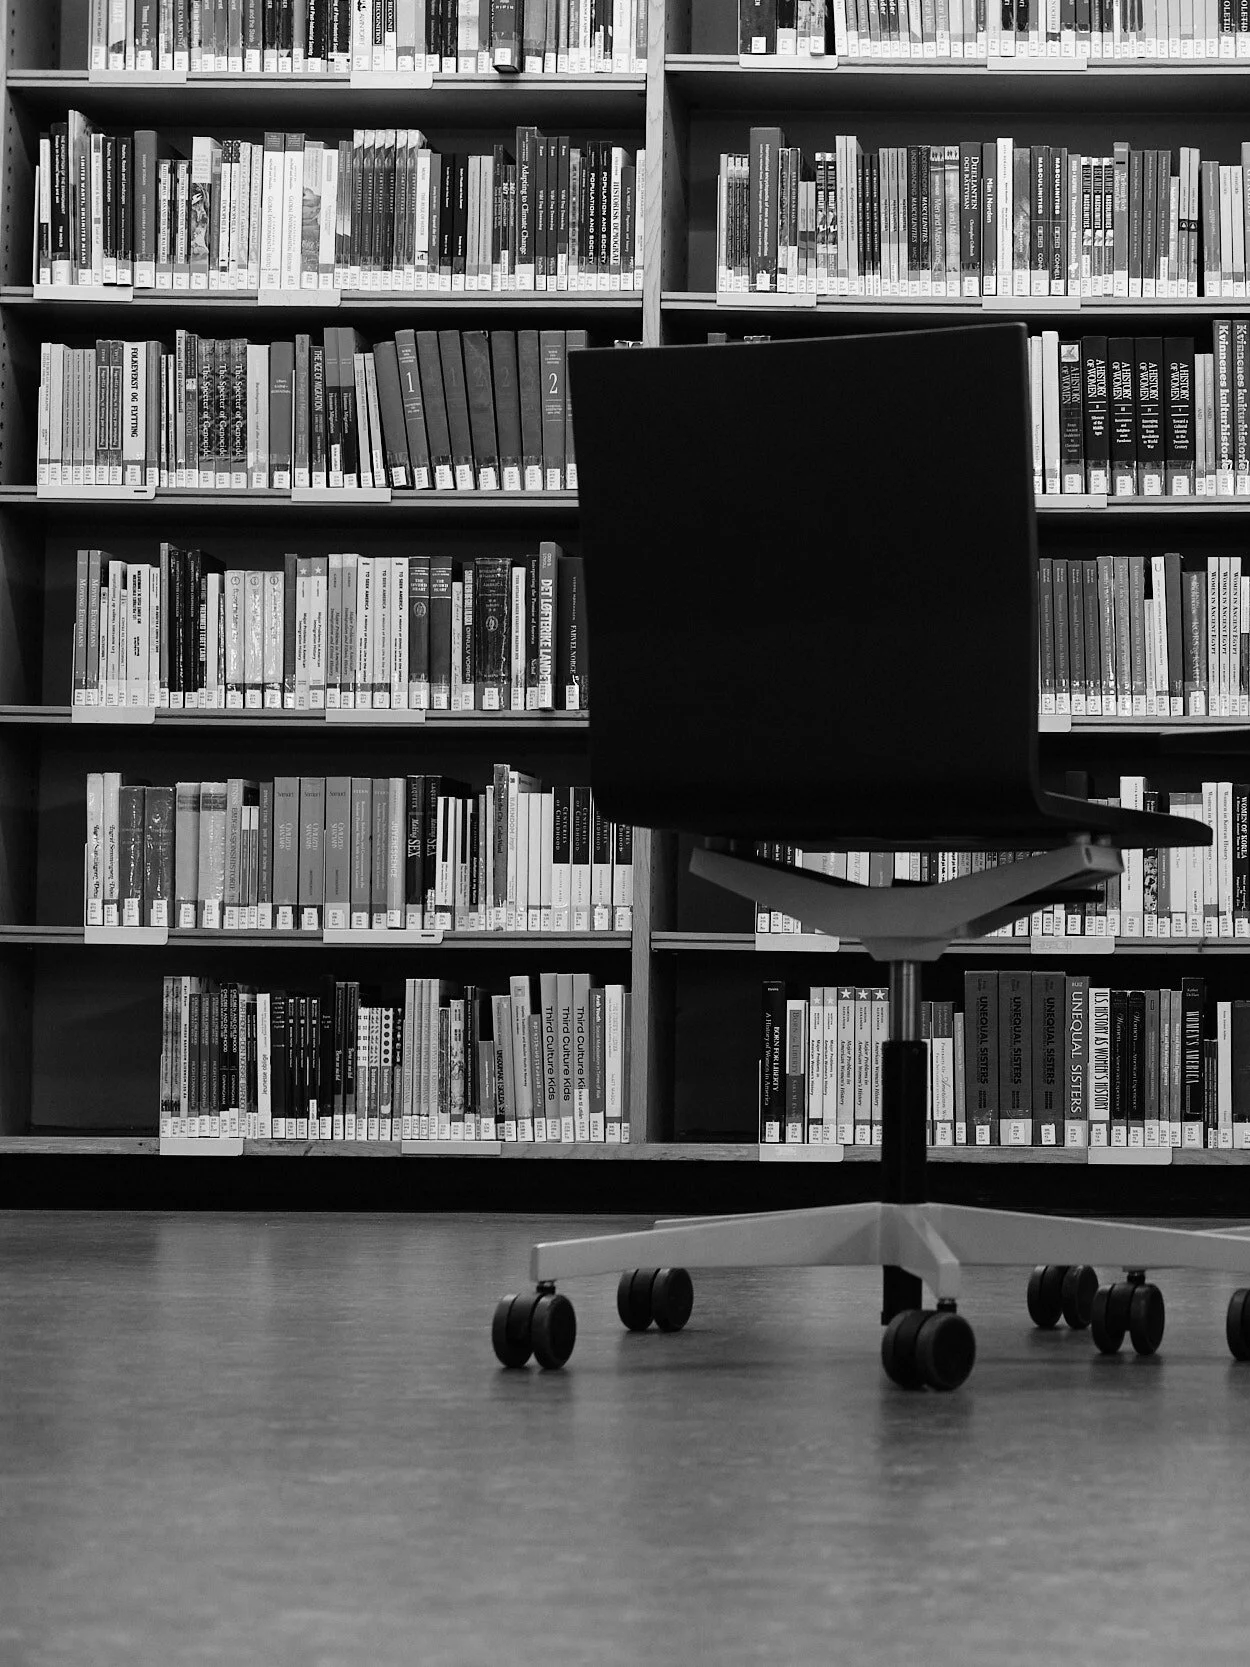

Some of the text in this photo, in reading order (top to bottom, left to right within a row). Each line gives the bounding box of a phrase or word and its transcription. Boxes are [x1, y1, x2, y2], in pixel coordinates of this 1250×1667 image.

[520, 165, 528, 194] Adapting
[520, 204, 528, 229] Climate
[520, 230, 528, 254] Change
[202, 364, 210, 379] The
[549, 373, 557, 393] 2
[1113, 362, 1121, 400] OF WOMEN
[1122, 368, 1131, 399] HISTORY
[131, 393, 138, 402] OG
[202, 381, 210, 409] Specter
[1219, 325, 1229, 469] Kvinnenes kulturhistorie
[202, 421, 210, 457] Genocide
[540, 579, 552, 684] DET LØFTERIKE LANDE
[1241, 825, 1247, 833] OF
[408, 839, 420, 857] SEX
[1070, 991, 1082, 1113] UNEQUAL SISTERS
[1095, 992, 1108, 1110] U.S. HISTORY AS WOMEN'S HISTORY
[548, 1078, 556, 1100] Kids
